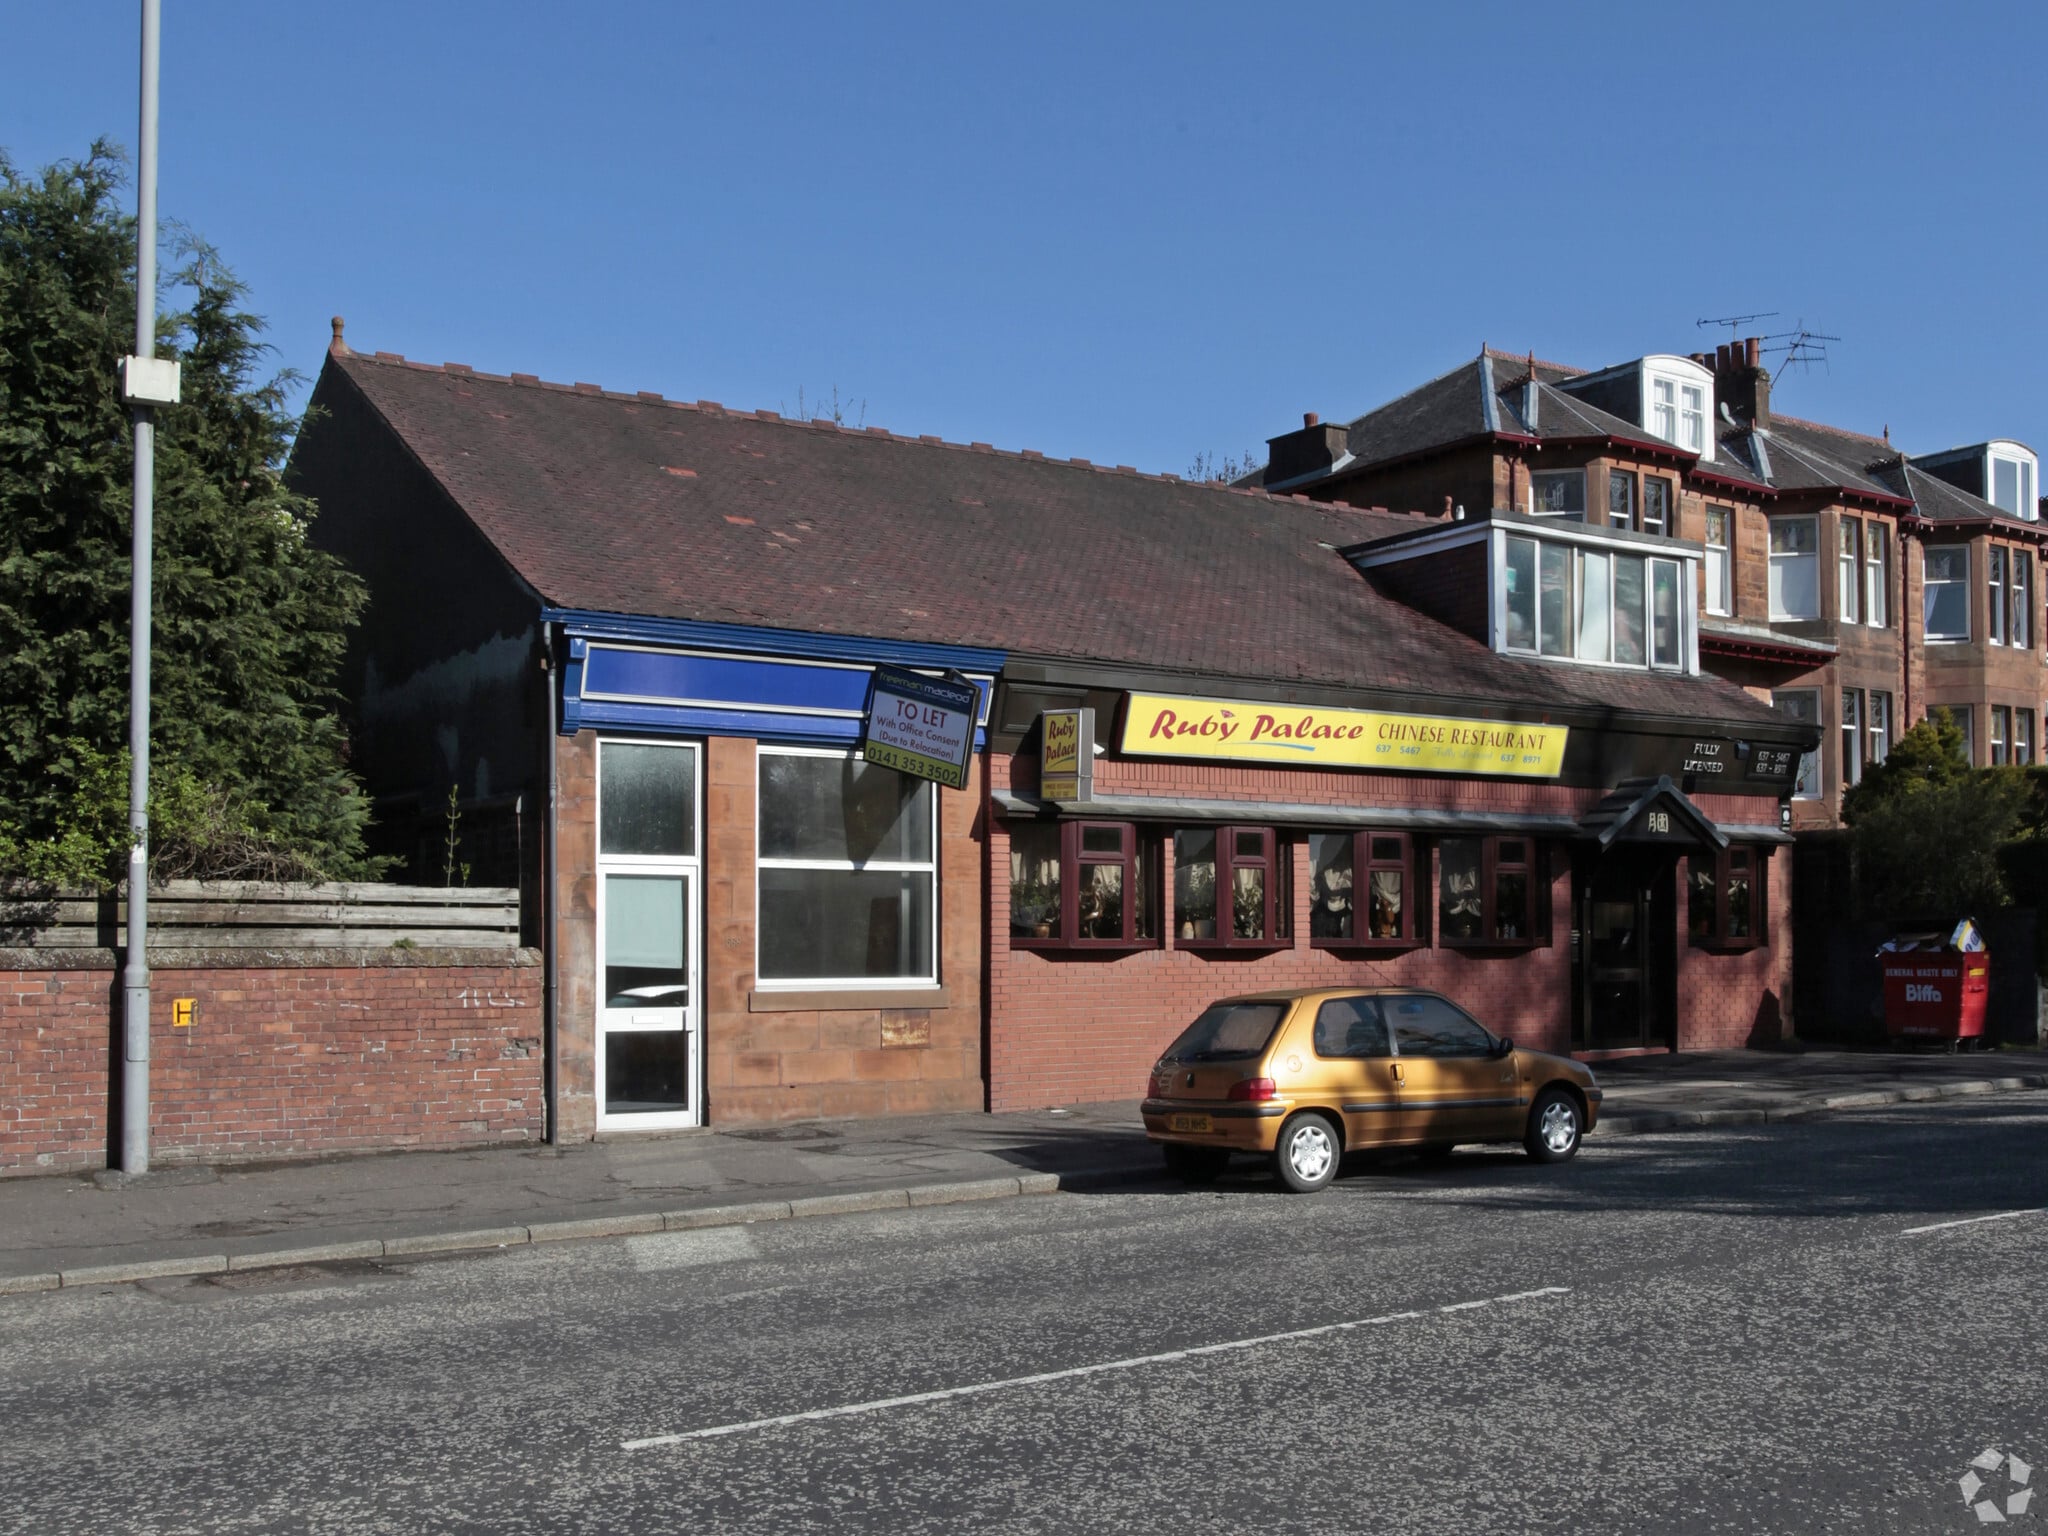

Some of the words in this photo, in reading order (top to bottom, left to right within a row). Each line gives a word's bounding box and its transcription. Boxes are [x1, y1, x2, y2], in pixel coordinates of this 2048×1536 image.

[880, 672, 922, 690] freeman
[924, 685, 970, 704] macleod
[897, 700, 918, 720] TO
[923, 707, 948, 728] LET
[876, 715, 896, 729] With
[899, 722, 923, 737] Office
[926, 731, 960, 747] Consent
[1049, 720, 1075, 740] Ruby
[1149, 709, 1239, 742] Ruby
[1250, 714, 1364, 741] Palace
[1378, 722, 1446, 743] CHINESE
[1451, 728, 1547, 750] RESTAURANT
[879, 730, 898, 743] (Due
[900, 737, 908, 746] to
[910, 740, 954, 761] Relocation)
[1046, 742, 1076, 764] Palace
[1693, 743, 1720, 755] FULLY
[868, 747, 898, 766] 0141
[902, 760, 924, 774] 353
[926, 767, 958, 784] 3502
[1683, 760, 1724, 773] LICENSED
[1906, 983, 1943, 1002] Biffa
[176, 1001, 195, 1024] H
